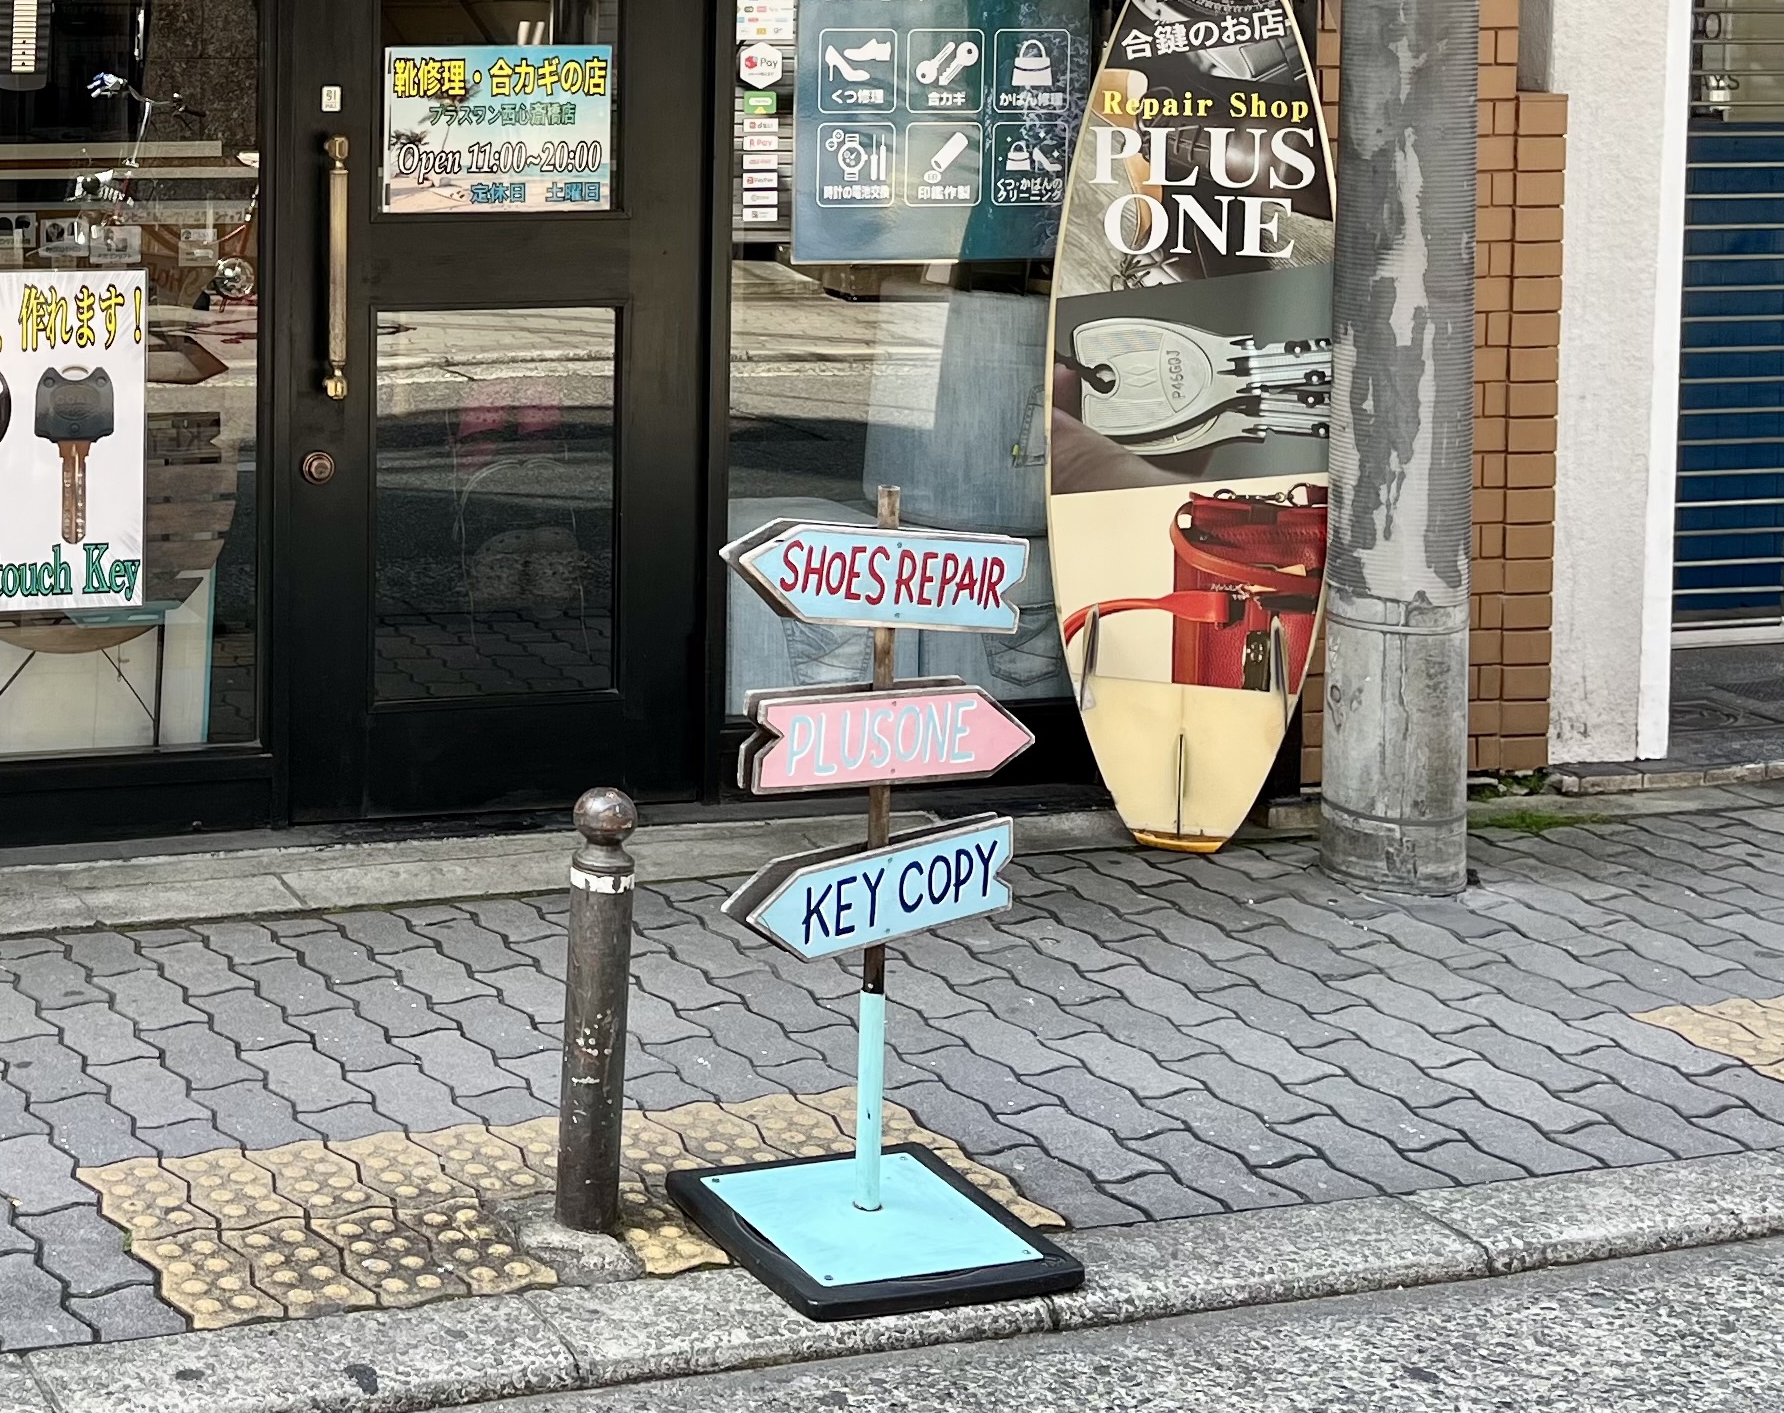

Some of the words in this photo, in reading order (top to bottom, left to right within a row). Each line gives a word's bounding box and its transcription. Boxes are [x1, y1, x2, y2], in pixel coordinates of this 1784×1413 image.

[1120, 8, 1285, 61] 合鍵のお店
[393, 55, 608, 97] 靴修理・合カギの店
[831, 89, 884, 105] くつ修理
[927, 91, 966, 106] 合カギ
[1101, 90, 1213, 119] Repair
[1228, 91, 1309, 123] Shop
[397, 143, 463, 184] Open
[1088, 125, 1316, 190] PLUS
[470, 182, 526, 204] 定休日
[545, 181, 601, 203] 土曜日
[1103, 192, 1294, 258] ONE
[82, 543, 142, 601] Key
[779, 539, 891, 606] SHOES
[894, 549, 1006, 610] REPAIR
[786, 698, 978, 780] PLUSONE
[802, 867, 886, 945] KEY
[898, 839, 1000, 915] COPY
